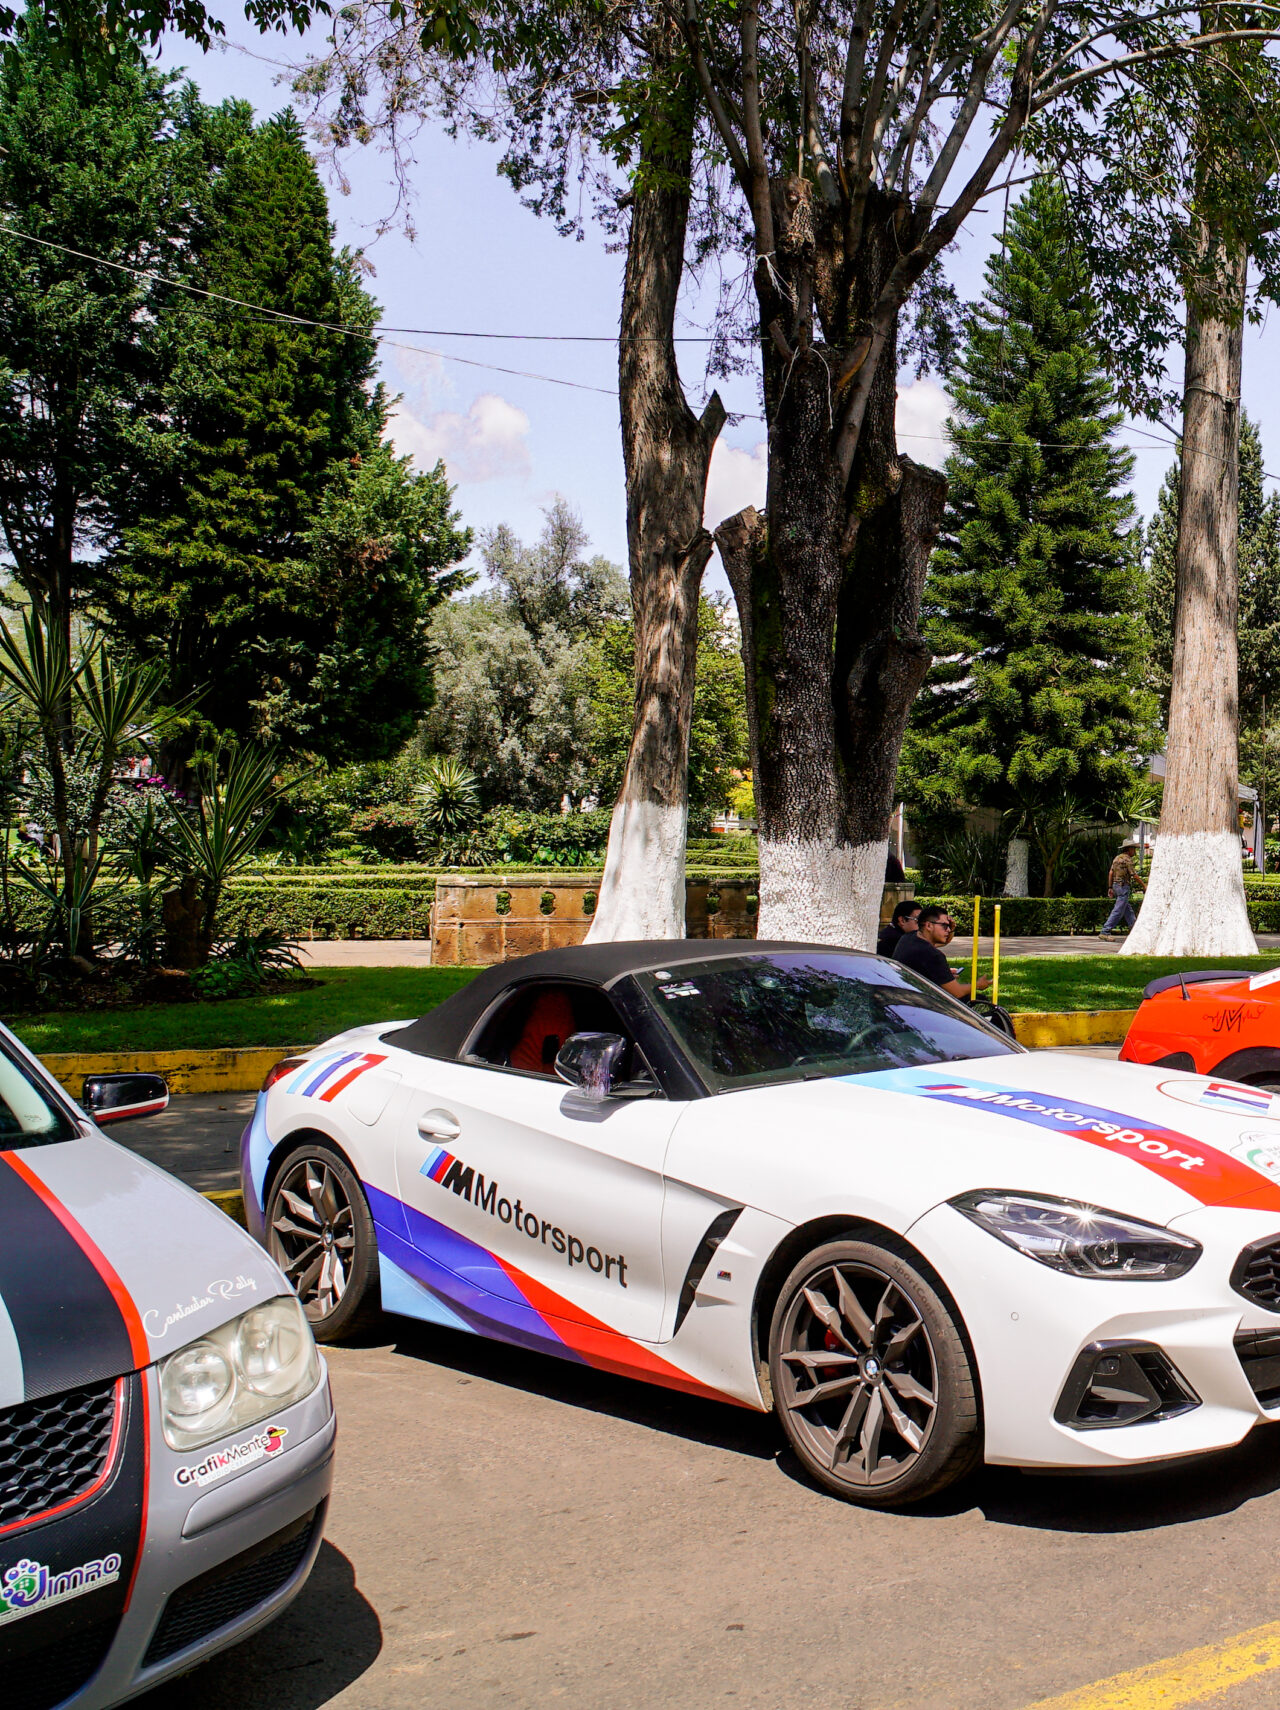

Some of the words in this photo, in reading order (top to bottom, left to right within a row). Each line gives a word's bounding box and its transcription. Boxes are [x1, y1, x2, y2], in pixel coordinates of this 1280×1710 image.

[983, 1092, 1205, 1170] Motorsport
[474, 1172, 629, 1289] Motorsport
[176, 1433, 269, 1485] GrafikMente
